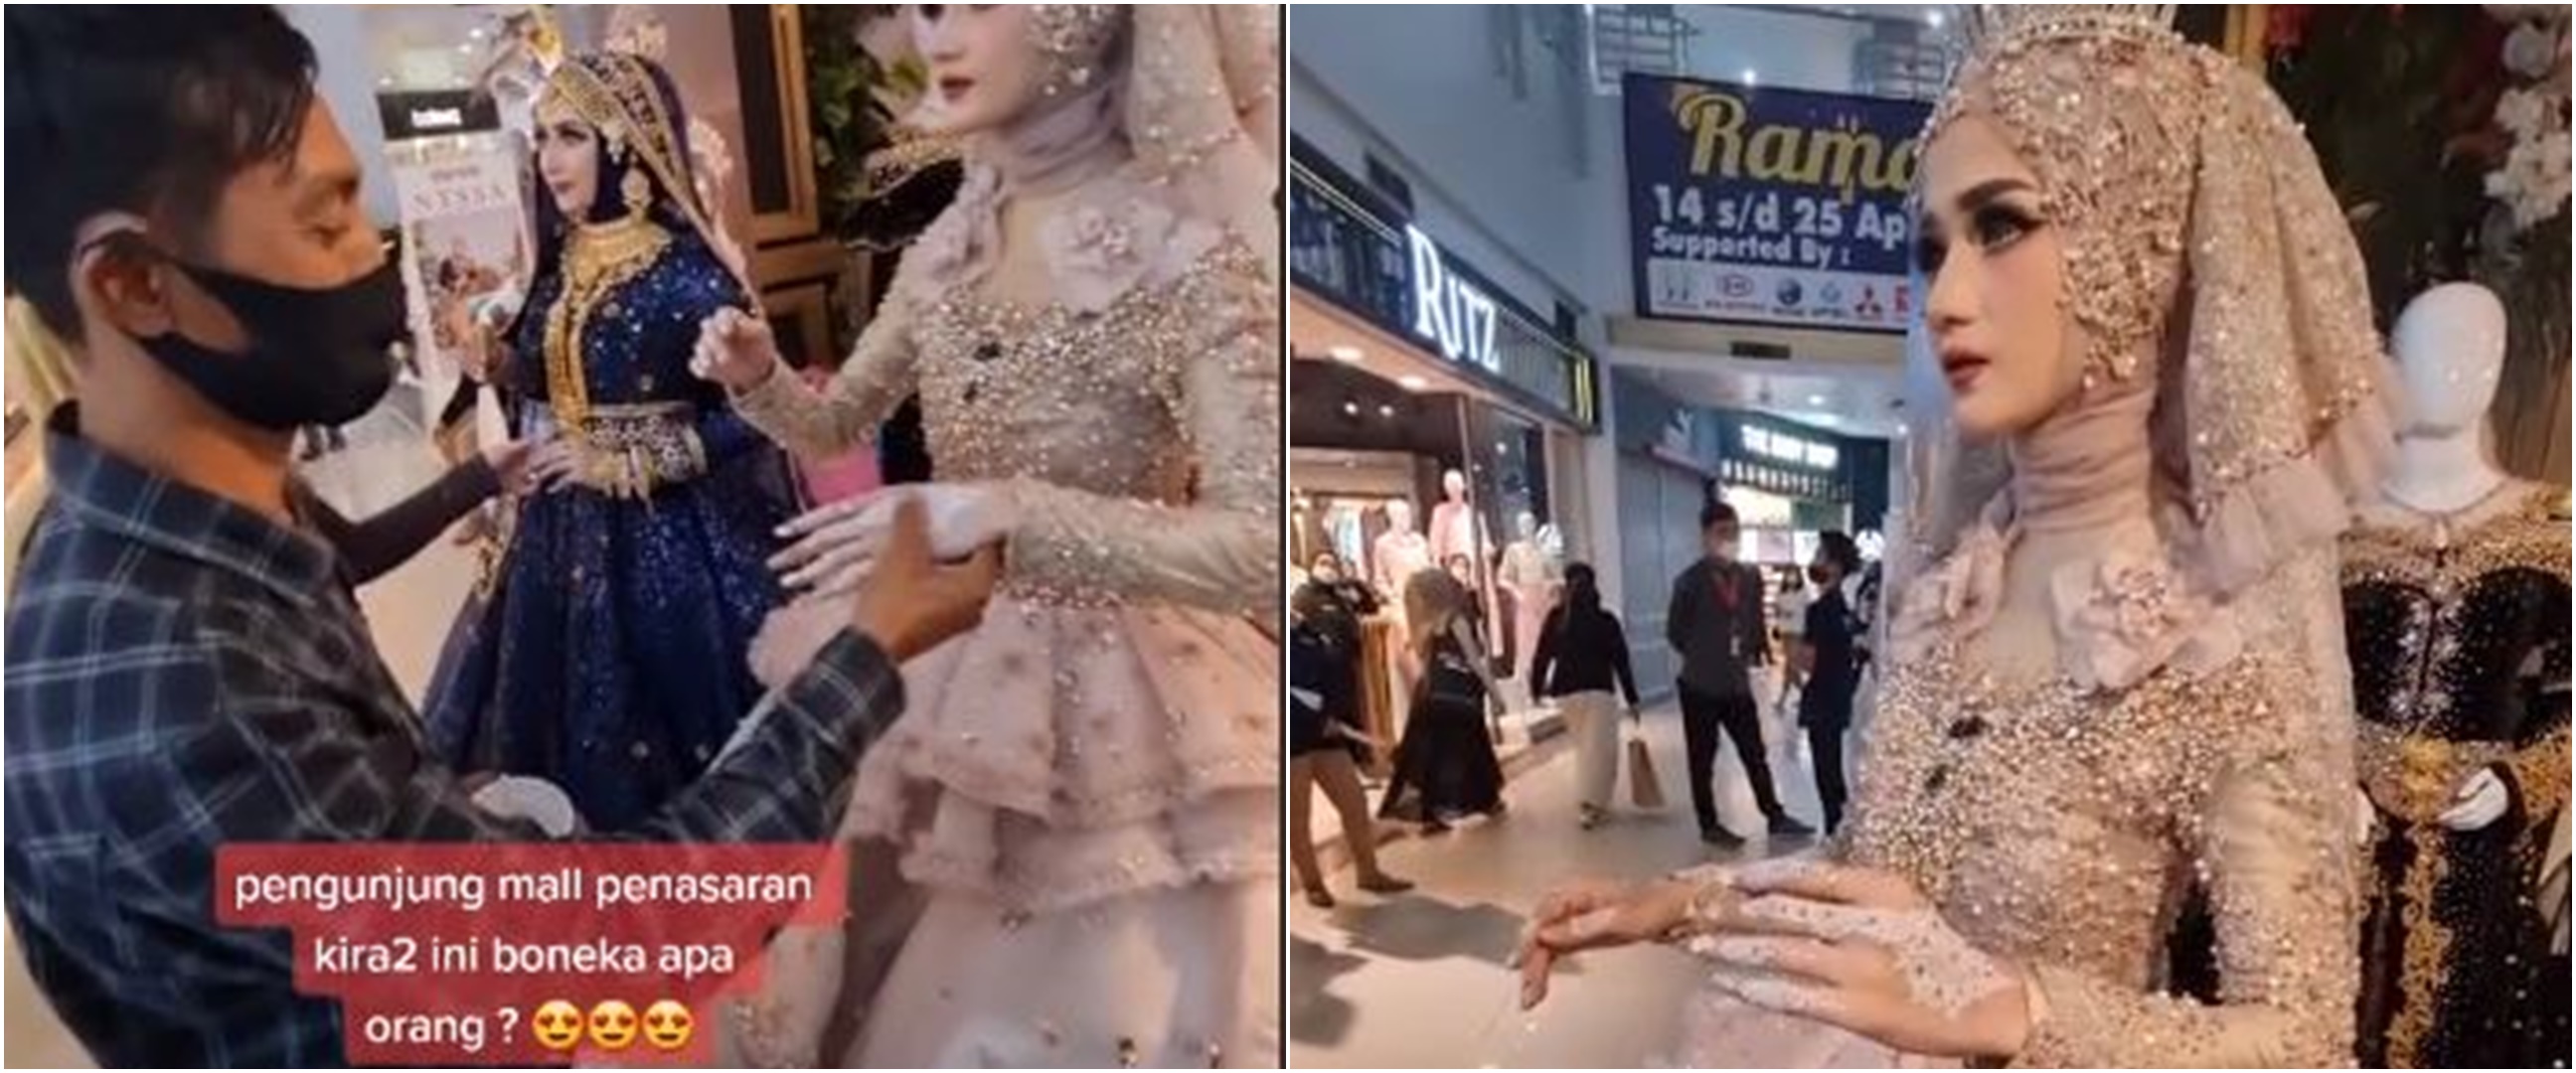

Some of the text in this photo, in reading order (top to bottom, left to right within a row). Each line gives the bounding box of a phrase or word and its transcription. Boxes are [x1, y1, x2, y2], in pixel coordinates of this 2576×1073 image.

[1654, 183, 1705, 226] 14
[1717, 192, 1780, 232] s/d
[1792, 197, 1845, 237] 25
[1652, 226, 1792, 261] Supported
[1799, 236, 1834, 270] By
[1405, 223, 1501, 375] RITZ
